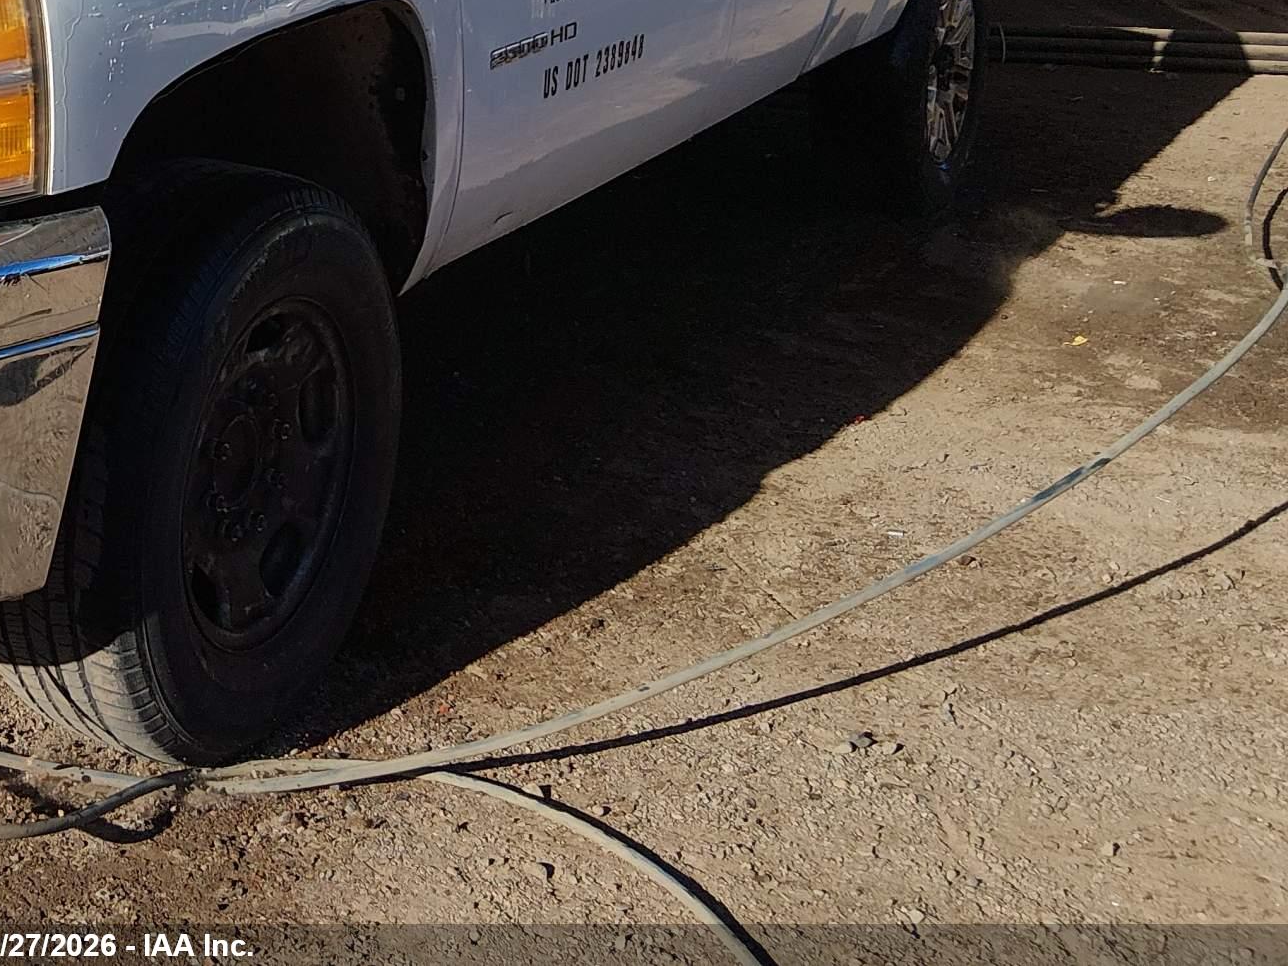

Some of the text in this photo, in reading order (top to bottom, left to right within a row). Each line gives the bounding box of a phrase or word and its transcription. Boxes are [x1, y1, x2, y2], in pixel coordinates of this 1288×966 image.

[543, 33, 646, 99] US DOT 2389848
